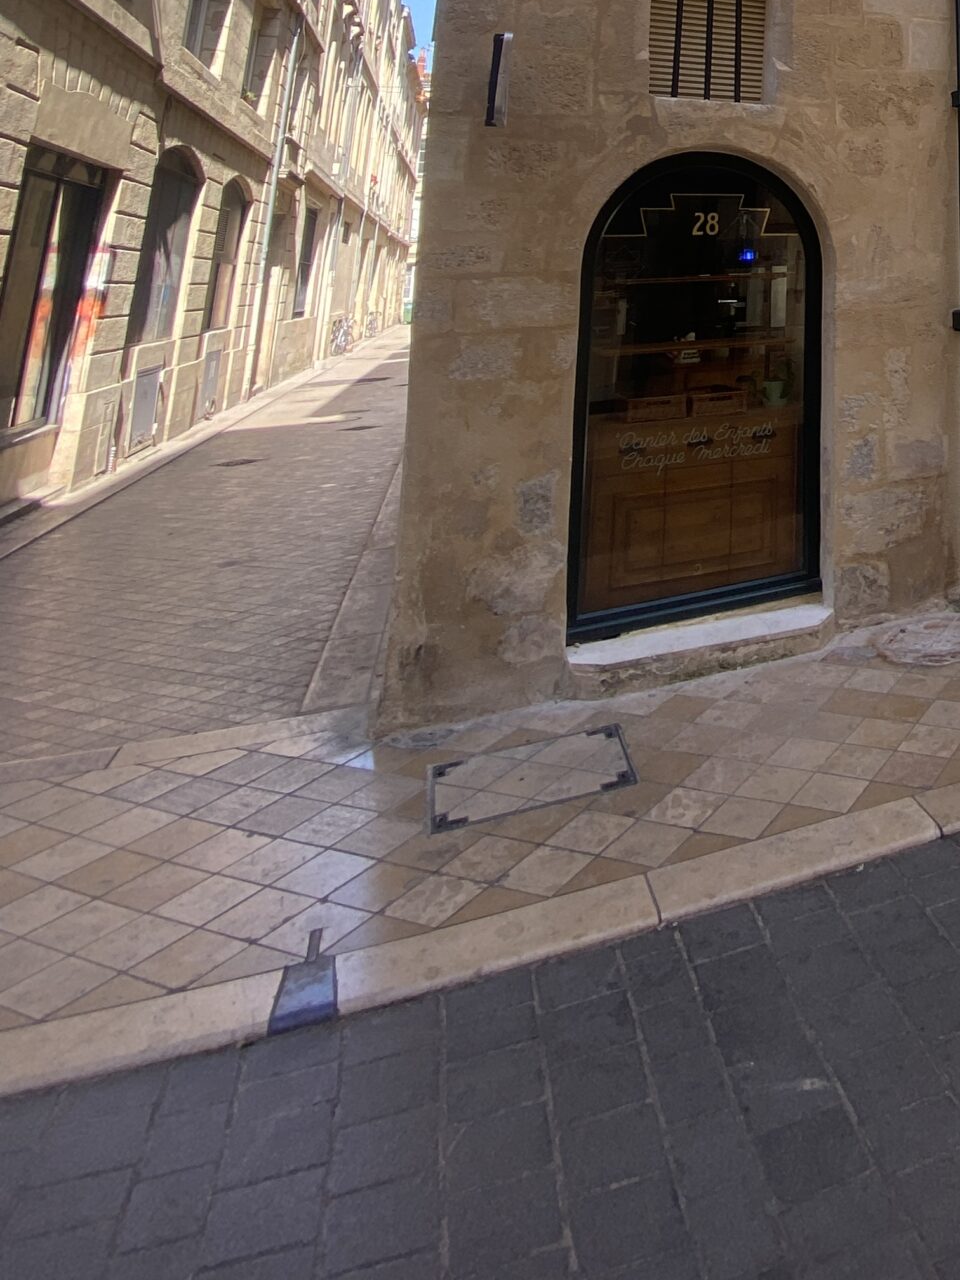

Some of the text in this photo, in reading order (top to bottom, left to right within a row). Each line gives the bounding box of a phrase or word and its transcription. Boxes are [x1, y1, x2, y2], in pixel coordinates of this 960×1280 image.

[692, 212, 719, 236] 28
[683, 427, 708, 444] des
[621, 452, 686, 475] Chaque
